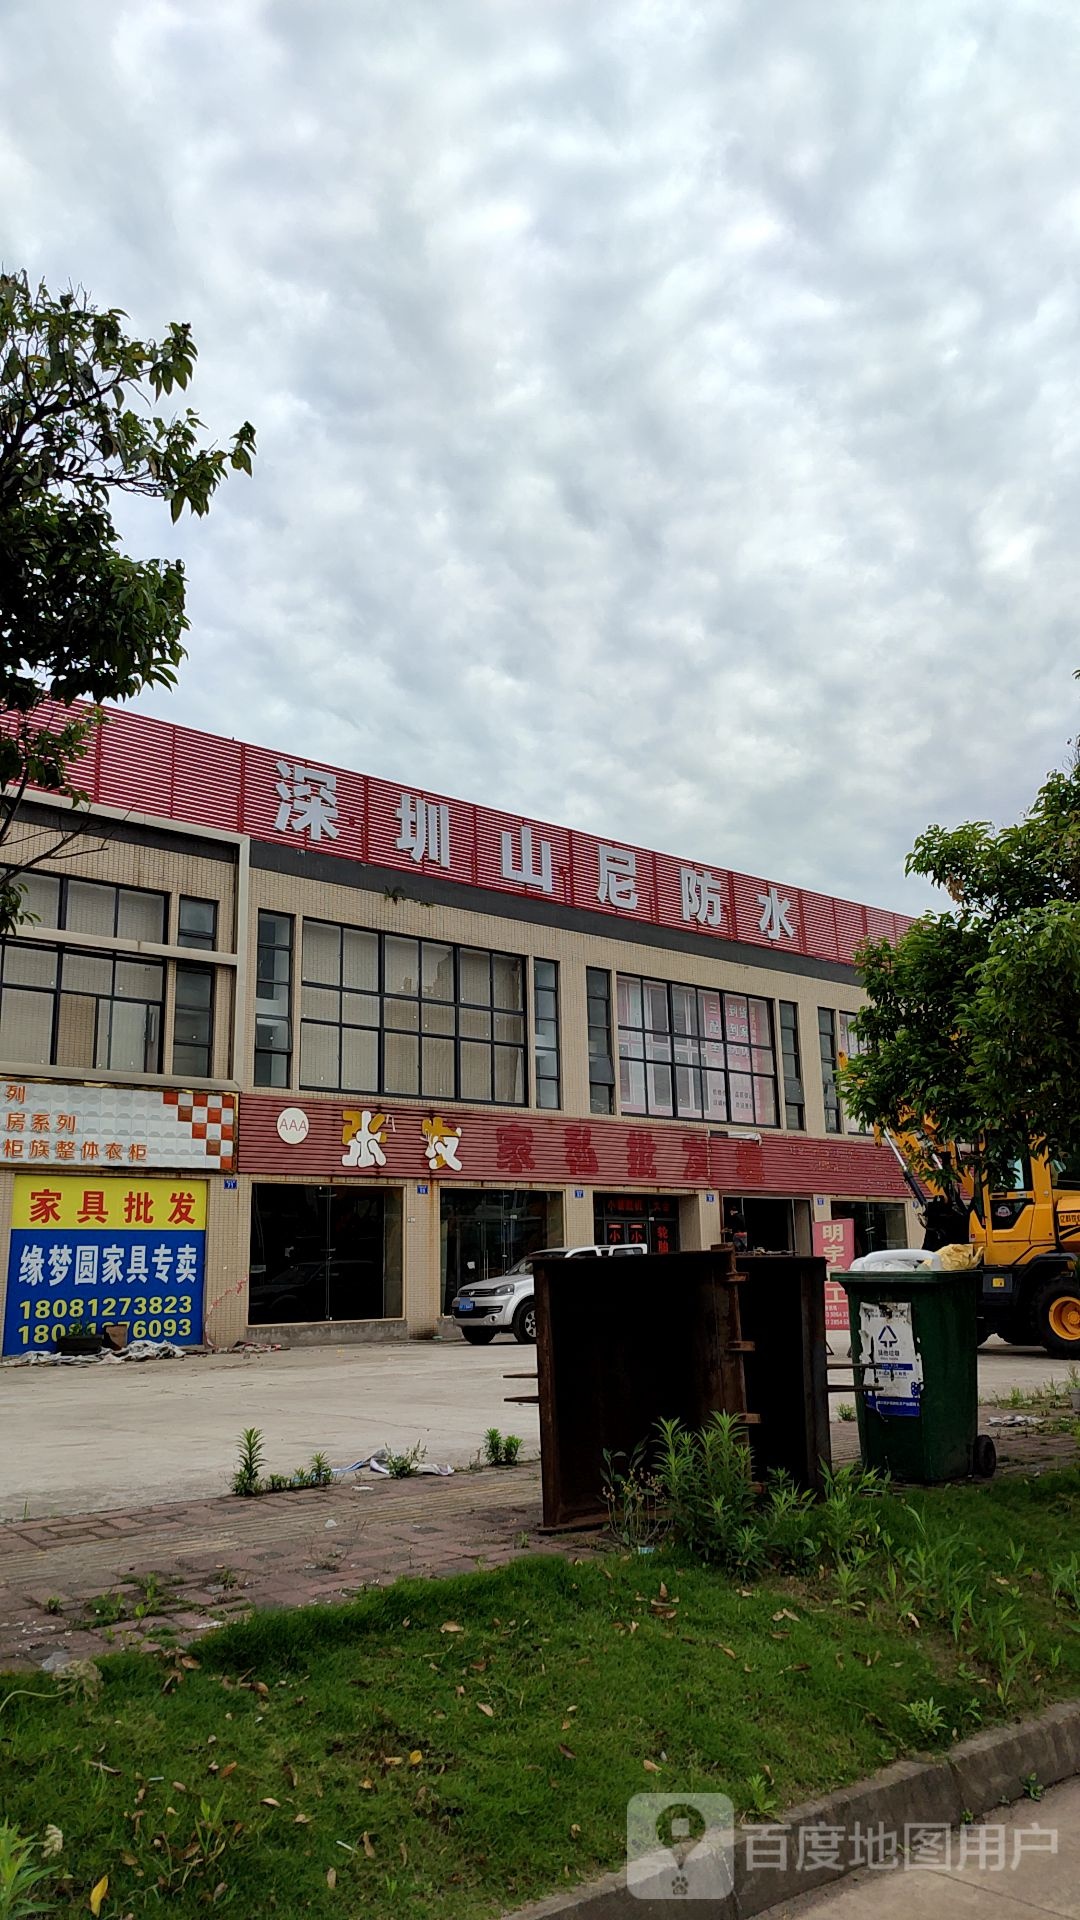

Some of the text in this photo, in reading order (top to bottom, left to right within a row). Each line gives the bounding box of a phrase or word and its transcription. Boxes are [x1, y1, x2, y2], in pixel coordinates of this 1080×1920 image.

[275, 760, 797, 941] 深圳山尼防水
[5, 1084, 26, 1105] 列
[6, 1112, 77, 1134] 房系列
[279, 1118, 307, 1132] AAA
[4, 1138, 148, 1162] 柜族整体衣柜
[29, 1188, 196, 1224] 家具批发
[18, 1244, 196, 1286] 缘梦圆家具专卖
[19, 1295, 192, 1319] 18081273823
